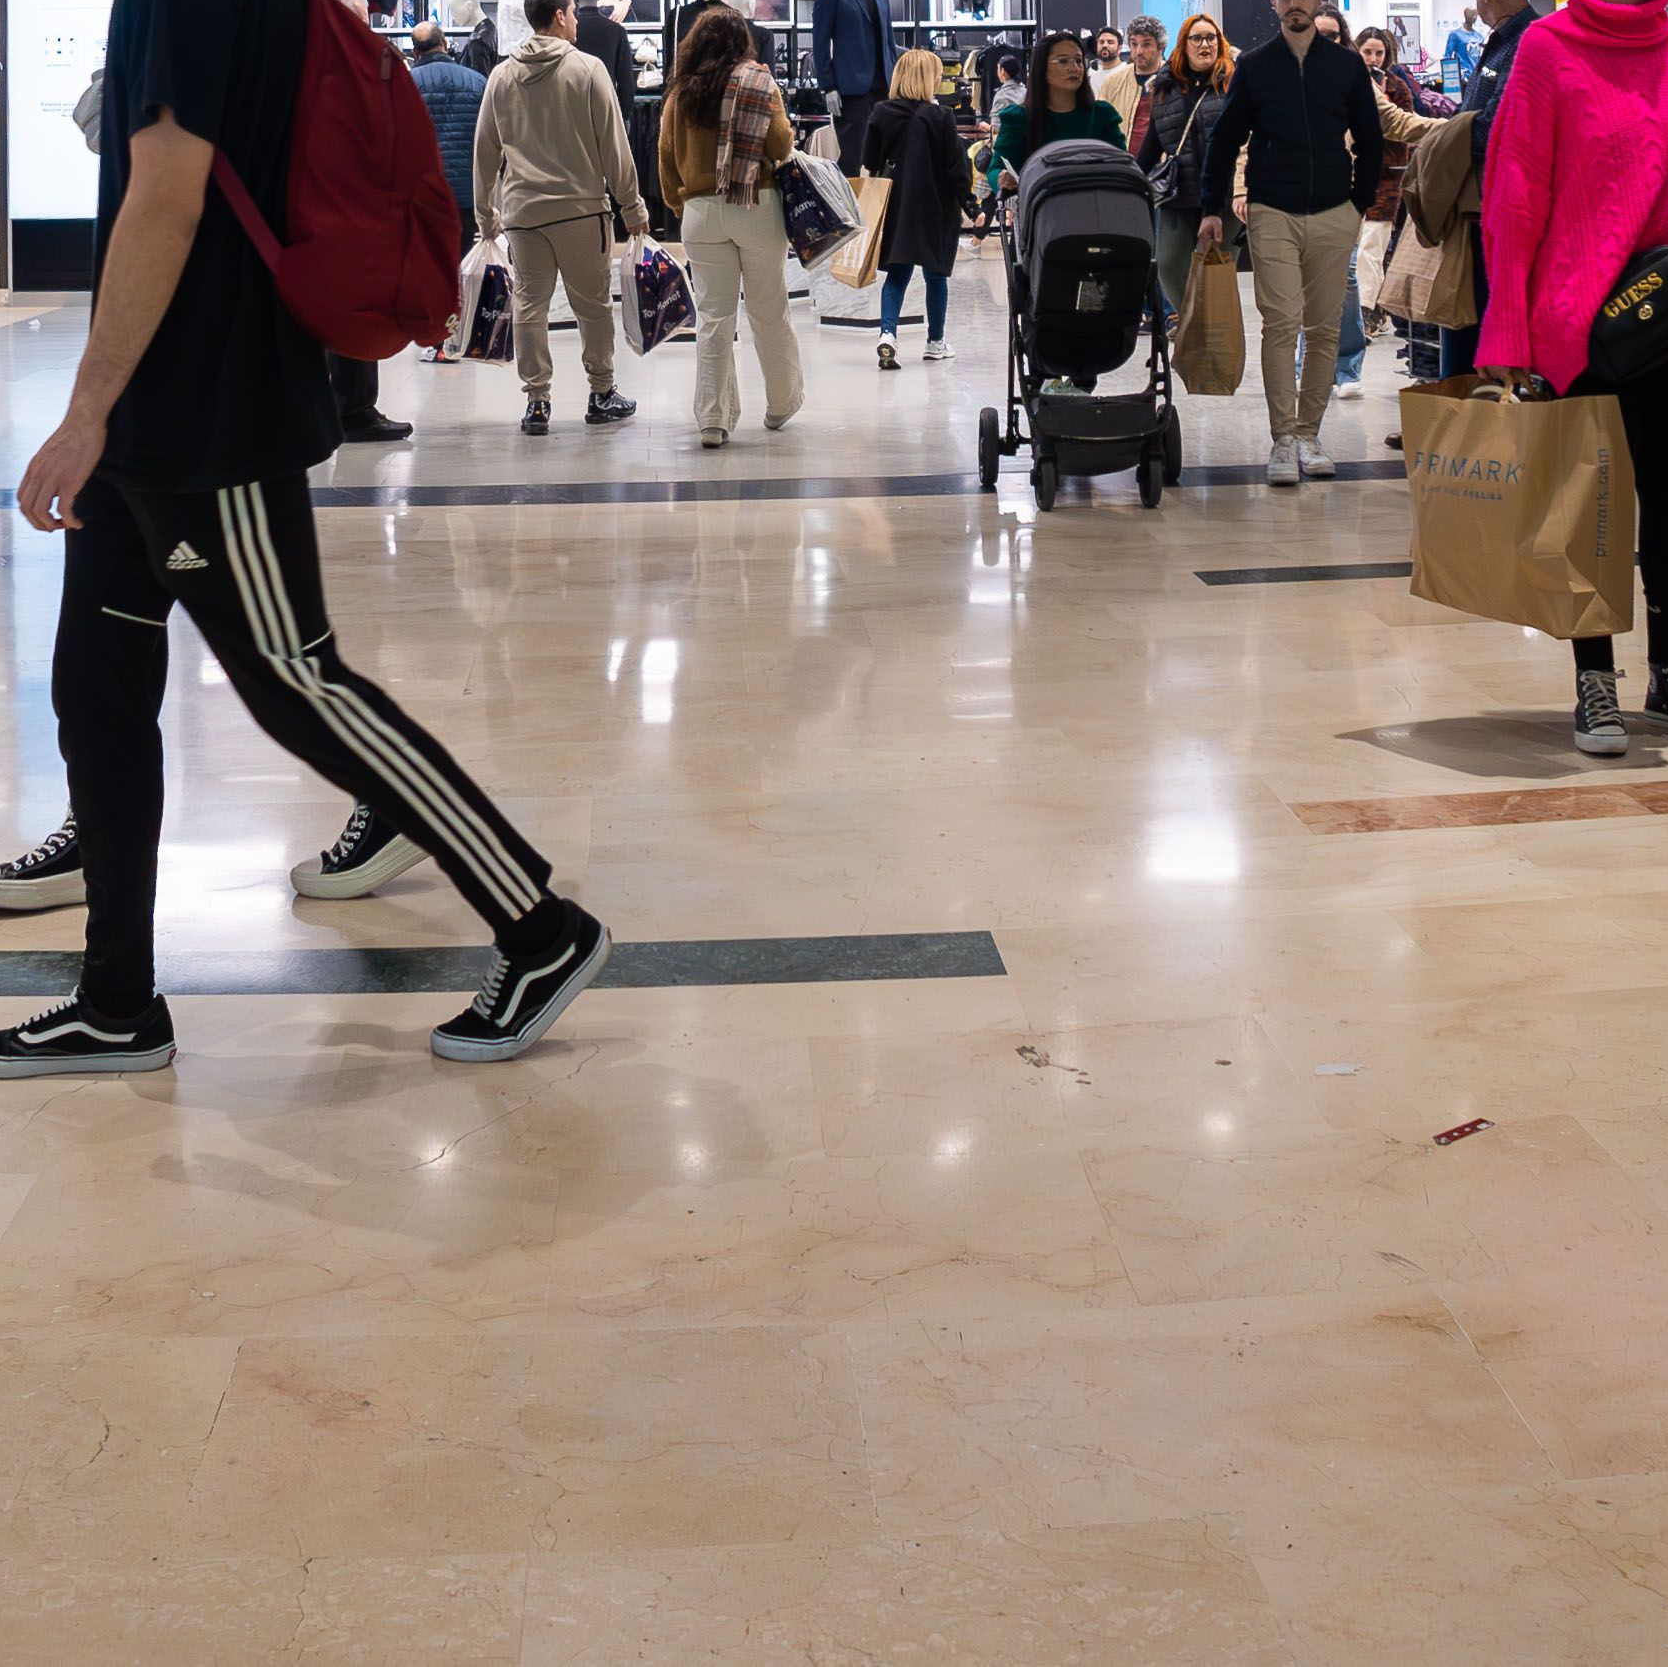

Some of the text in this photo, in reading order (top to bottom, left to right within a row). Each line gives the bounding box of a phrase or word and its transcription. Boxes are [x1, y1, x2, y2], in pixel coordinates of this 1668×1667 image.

[1604, 273, 1663, 317] GUESS
[1414, 451, 1519, 484] PRIMARK
[1596, 448, 1609, 557] primark.com
